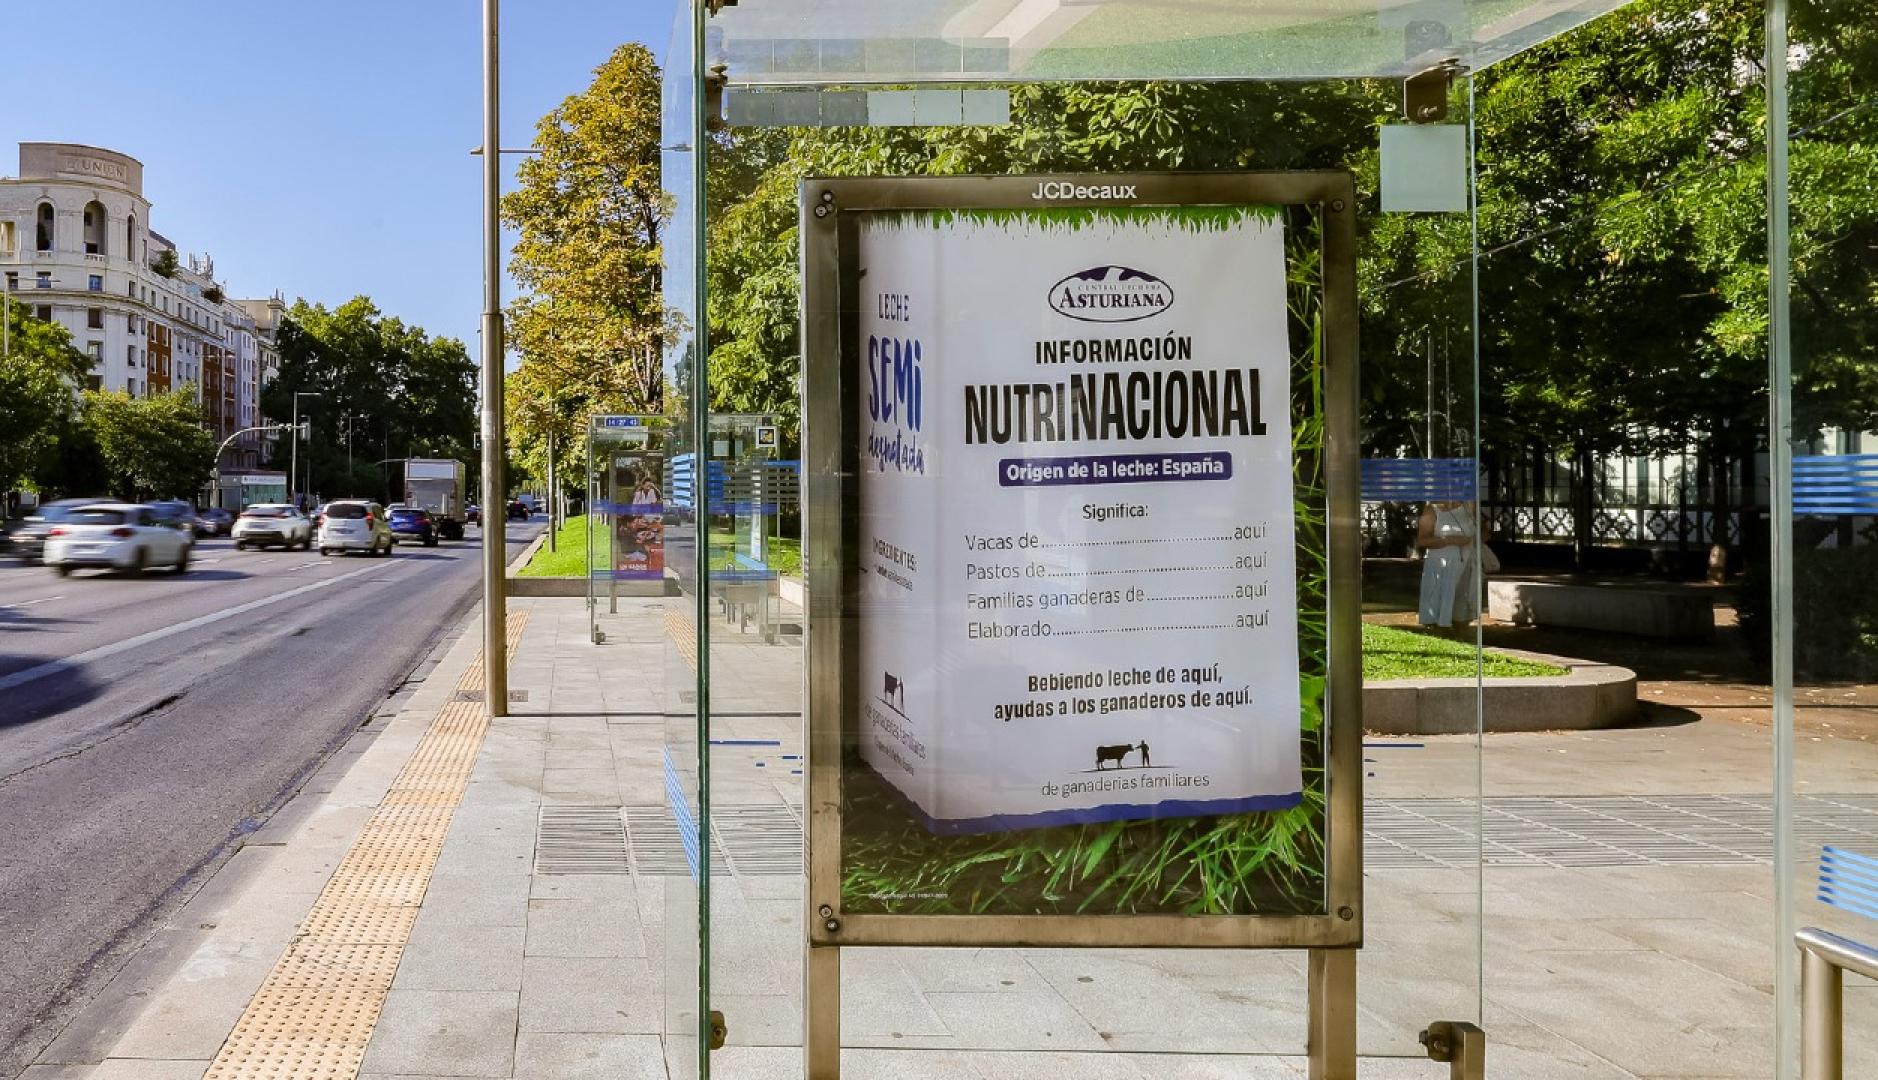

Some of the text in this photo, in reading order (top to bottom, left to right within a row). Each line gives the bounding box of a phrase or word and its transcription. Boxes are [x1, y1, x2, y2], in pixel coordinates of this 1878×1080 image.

[1031, 182, 1138, 200] JCDecaux
[878, 293, 910, 322] LECHE
[1035, 330, 1192, 365] INFORMACIÓN
[964, 368, 1267, 445] NUTRINACIONAL
[1006, 456, 1225, 482] Origen de la leche: España
[1082, 503, 1149, 522] Significa:
[965, 521, 1267, 550] Vacas de aquí
[966, 564, 1019, 580] Pastos
[1025, 562, 1046, 578] de
[967, 580, 1268, 610] Familias ganaderas de aquí
[968, 609, 1270, 640] Elaborado aquí
[1028, 663, 1222, 692] Bebiendo leche de aquí,
[994, 685, 1253, 722] ayudas a los ganaderos de aquí.
[1041, 779, 1059, 796] de
[1140, 773, 1210, 788] familiares
